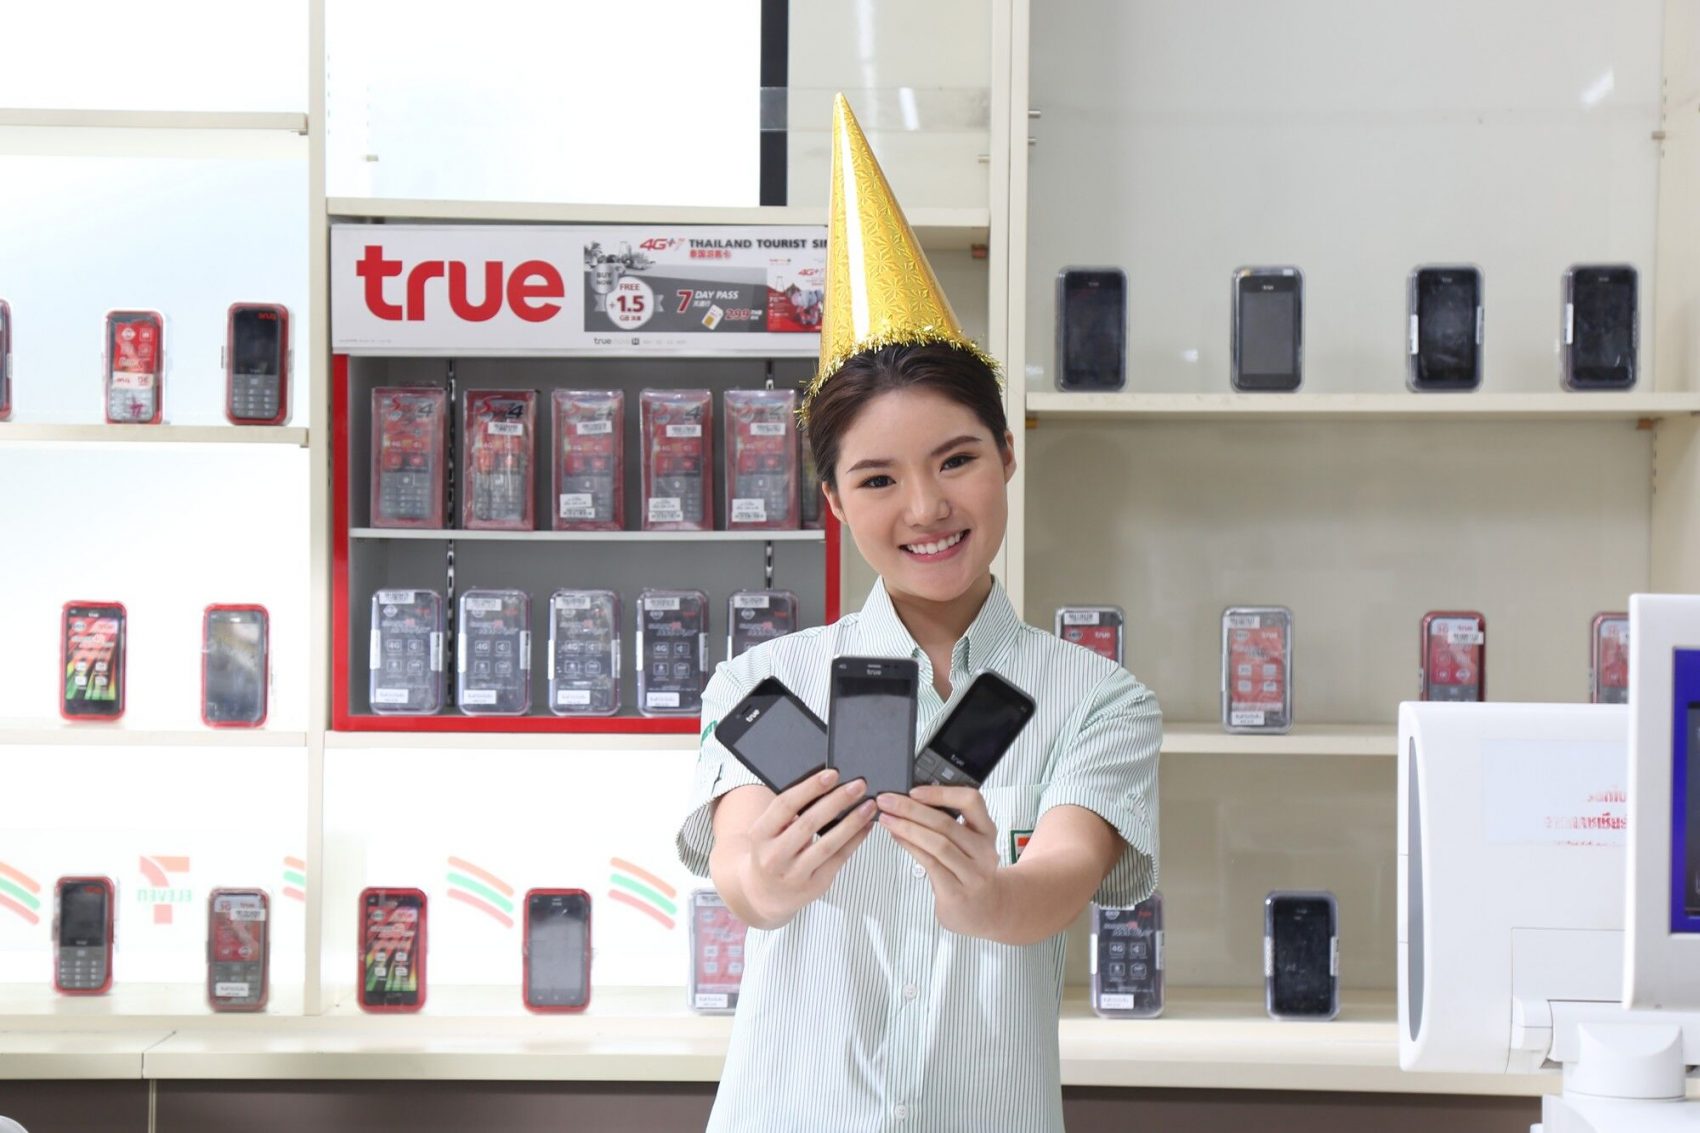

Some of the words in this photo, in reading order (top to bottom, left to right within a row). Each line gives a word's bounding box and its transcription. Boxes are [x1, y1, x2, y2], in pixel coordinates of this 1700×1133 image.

[689, 239, 752, 249] THAILAND
[757, 239, 807, 249] TOURIST
[356, 245, 565, 323] true
[619, 283, 641, 291] FREE
[676, 289, 694, 314] 7
[694, 290, 715, 300] DAY
[715, 290, 739, 300] PASS
[866, 669, 882, 677] true
[746, 709, 760, 723] true
